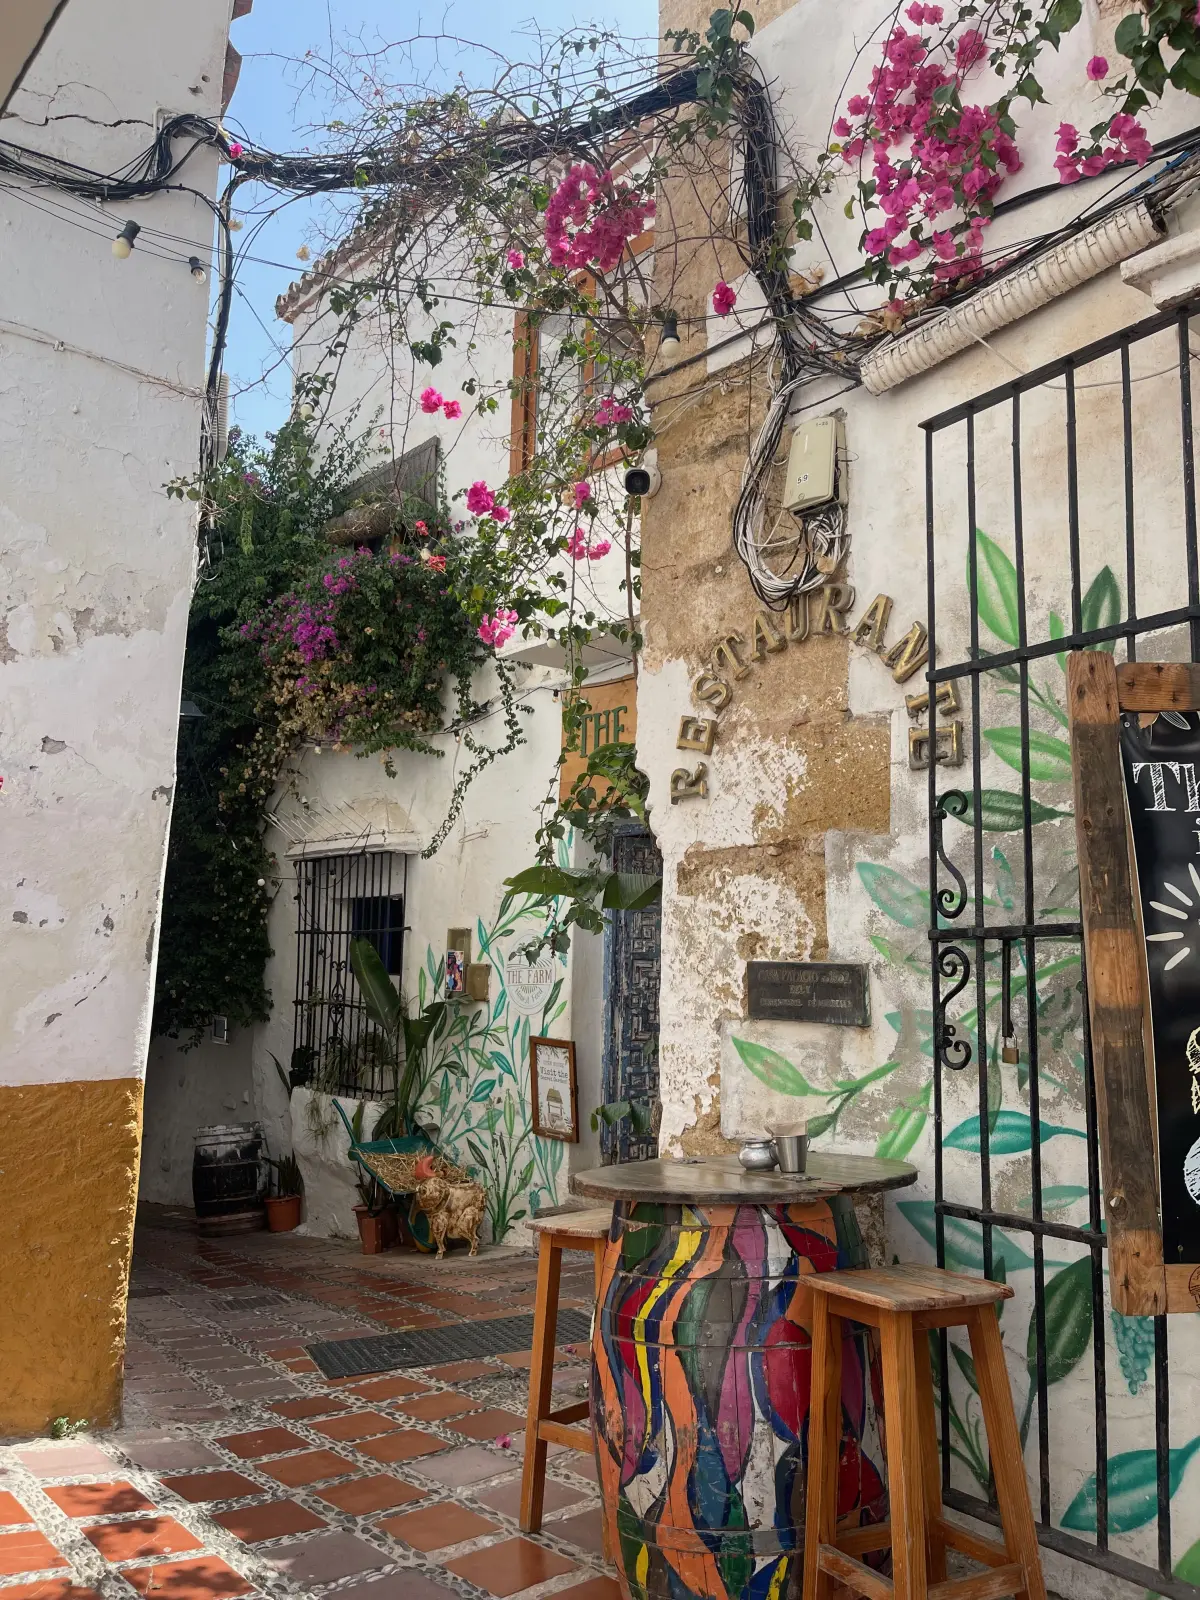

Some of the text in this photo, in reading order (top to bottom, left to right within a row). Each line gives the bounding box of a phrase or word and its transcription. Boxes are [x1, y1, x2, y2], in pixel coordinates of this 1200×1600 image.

[797, 474, 809, 485] 59
[670, 583, 963, 805] RESTAURANTE
[506, 969, 552, 984] THE FARM
[540, 1066, 568, 1079] Visit the
